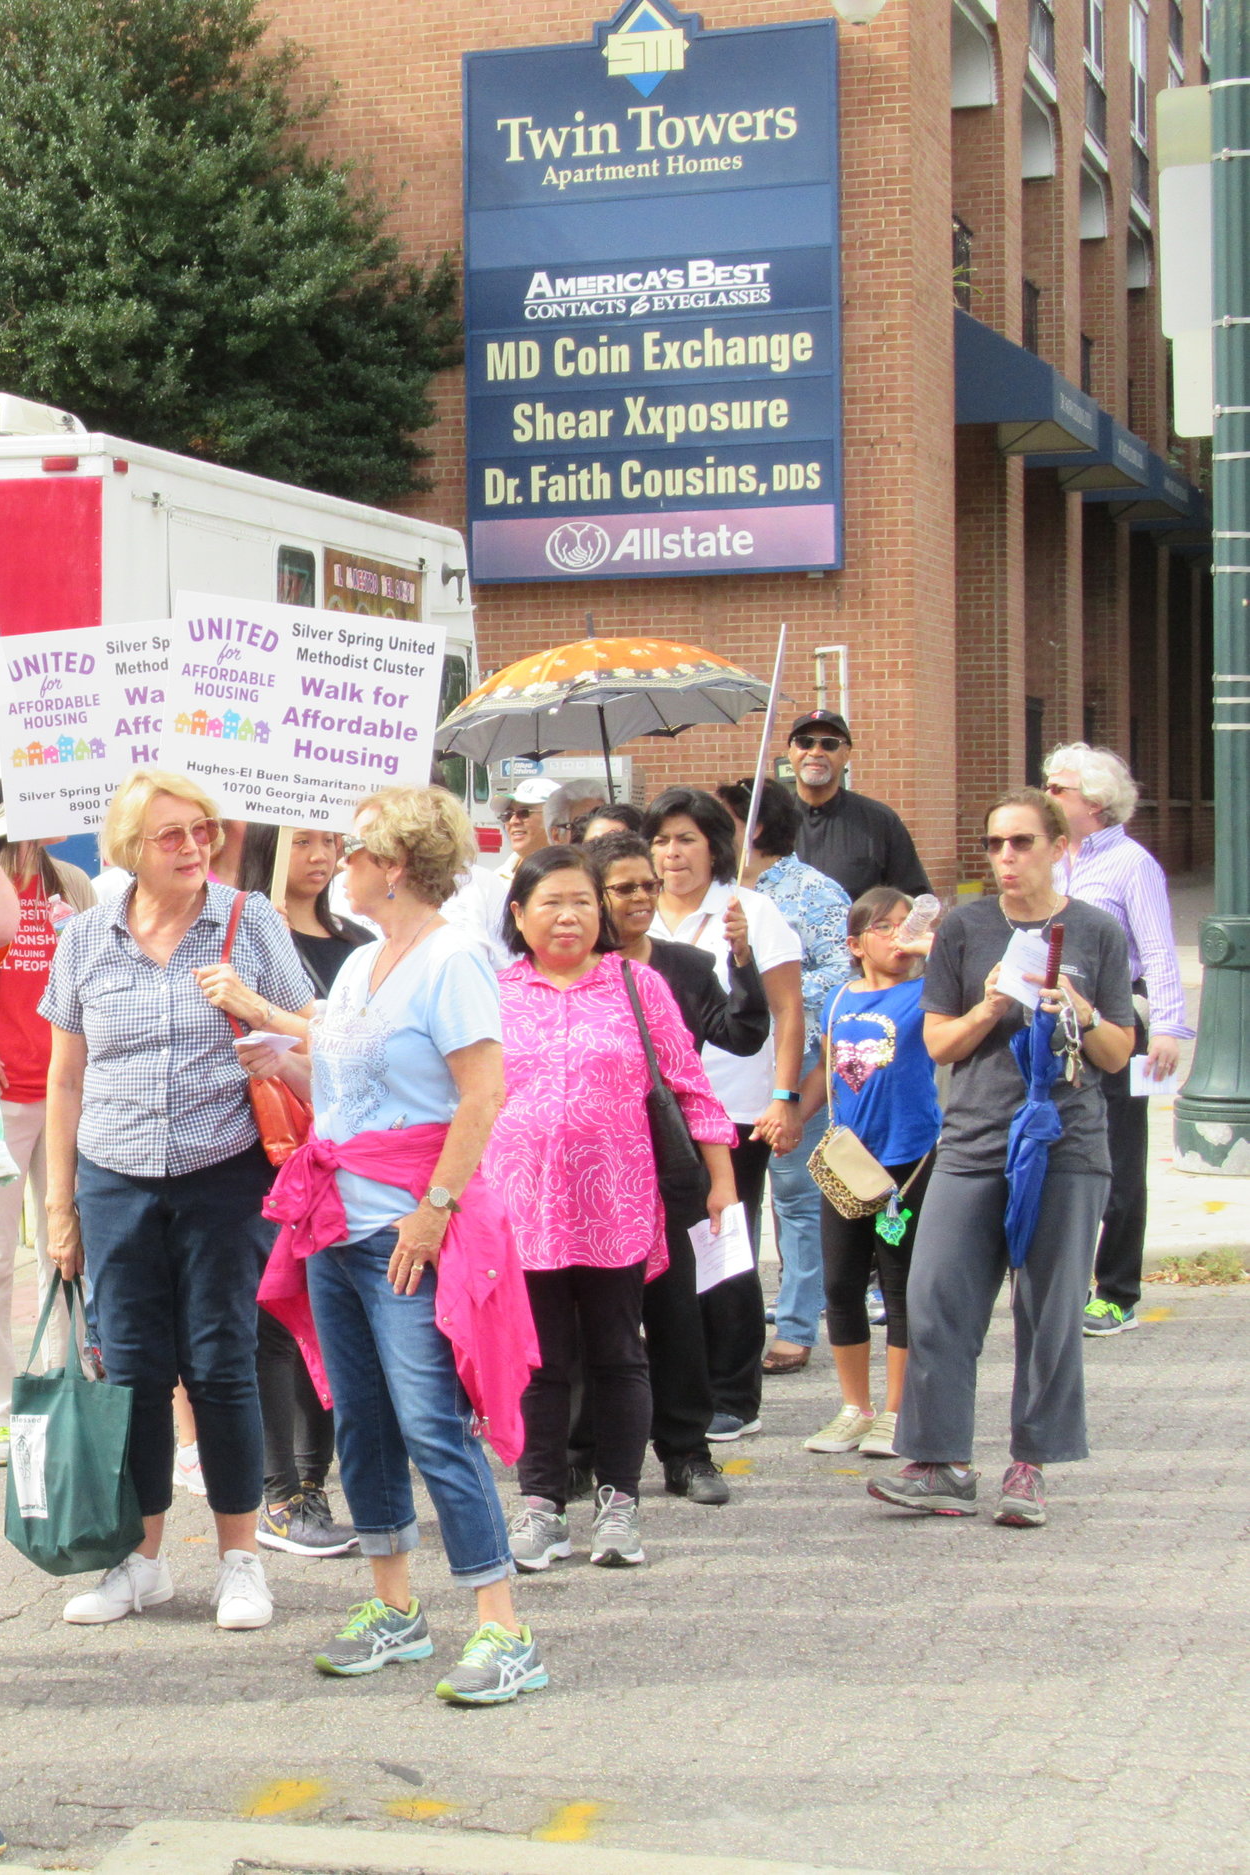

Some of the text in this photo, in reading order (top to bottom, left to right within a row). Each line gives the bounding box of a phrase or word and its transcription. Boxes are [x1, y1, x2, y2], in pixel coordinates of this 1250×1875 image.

[497, 105, 798, 162] Twin Towers
[542, 154, 743, 190] Apartment Homes
[524, 299, 626, 319] CONTACTS
[652, 288, 771, 311] EYEGLASSES
[487, 328, 813, 381] MD Coin Exchange
[513, 396, 789, 442] Shear Xxposure
[484, 456, 821, 505] Dr. Faith Cousins, DDS
[611, 525, 754, 560] Allstate
[106, 639, 147, 655] Silver
[188, 617, 279, 653] UNITED
[291, 623, 435, 655] Silver Spring United
[7, 652, 95, 682] UNITED
[115, 658, 169, 676] Method
[216, 642, 242, 666] for
[296, 648, 425, 677] Methodist Cluster
[40, 675, 63, 698] for
[181, 662, 276, 688] AFFORDABLE
[8, 694, 100, 715] AFFORDABLE
[125, 686, 165, 706] Wa
[194, 682, 260, 703] HOUSING
[301, 676, 409, 708] Walk for
[24, 711, 88, 730] HOUSING
[281, 706, 419, 741] Affordable
[293, 738, 399, 775] Housing
[186, 760, 252, 778] Hughes-El
[256, 769, 289, 783] Buen
[293, 773, 366, 793] Samaritano
[19, 790, 55, 802] Silver
[59, 785, 101, 798] Spring
[70, 799, 100, 811] 8900
[222, 781, 358, 806] 10700 Georgia Avenu
[245, 801, 330, 820] Wheaton, MD
[8, 950, 45, 958] VALUING
